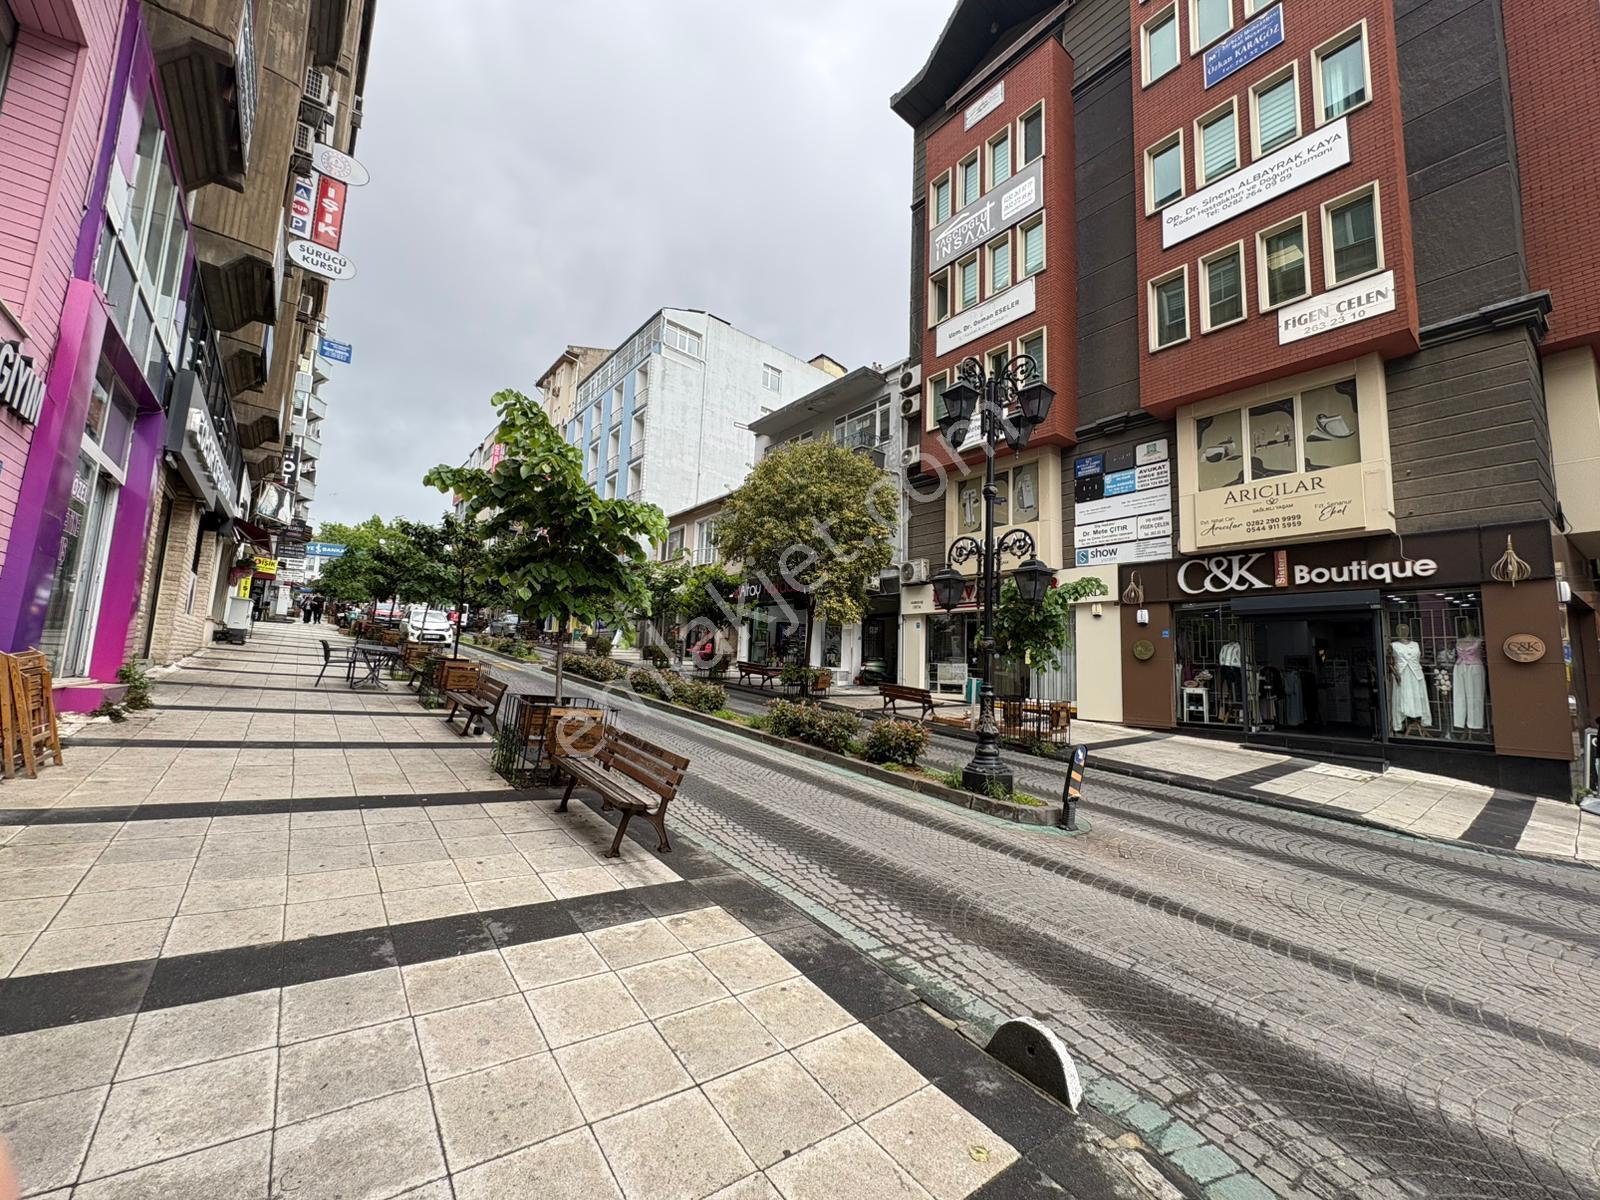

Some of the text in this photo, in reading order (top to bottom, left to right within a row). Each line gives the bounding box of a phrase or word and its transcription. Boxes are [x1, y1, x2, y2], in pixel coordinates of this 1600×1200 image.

[1235, 23, 1280, 58] KARAGÖZ
[1166, 133, 1342, 225] Op. Dr. Sinem ALBAYRAK KAYA
[1246, 183, 1257, 193] ve
[1222, 196, 1244, 211] 0282
[1245, 187, 1263, 200] 264
[292, 217, 303, 230] P
[299, 243, 347, 267] SÜRÜCÜ
[302, 255, 342, 275] KURSU
[994, 299, 1021, 316] ESELER
[1336, 286, 1389, 316] ÇELEN
[1304, 309, 1366, 335] 263 23 10
[1139, 464, 1166, 474] AVUKAT
[1224, 476, 1326, 505] ARICILAR
[1246, 519, 1264, 527] 0282
[1281, 514, 1302, 522] 9999
[1246, 526, 1266, 534] 0544
[1282, 520, 1302, 528] 5959
[1090, 547, 1118, 559] show
[1177, 552, 1272, 594] C&K
[1294, 558, 1438, 584] Boutique
